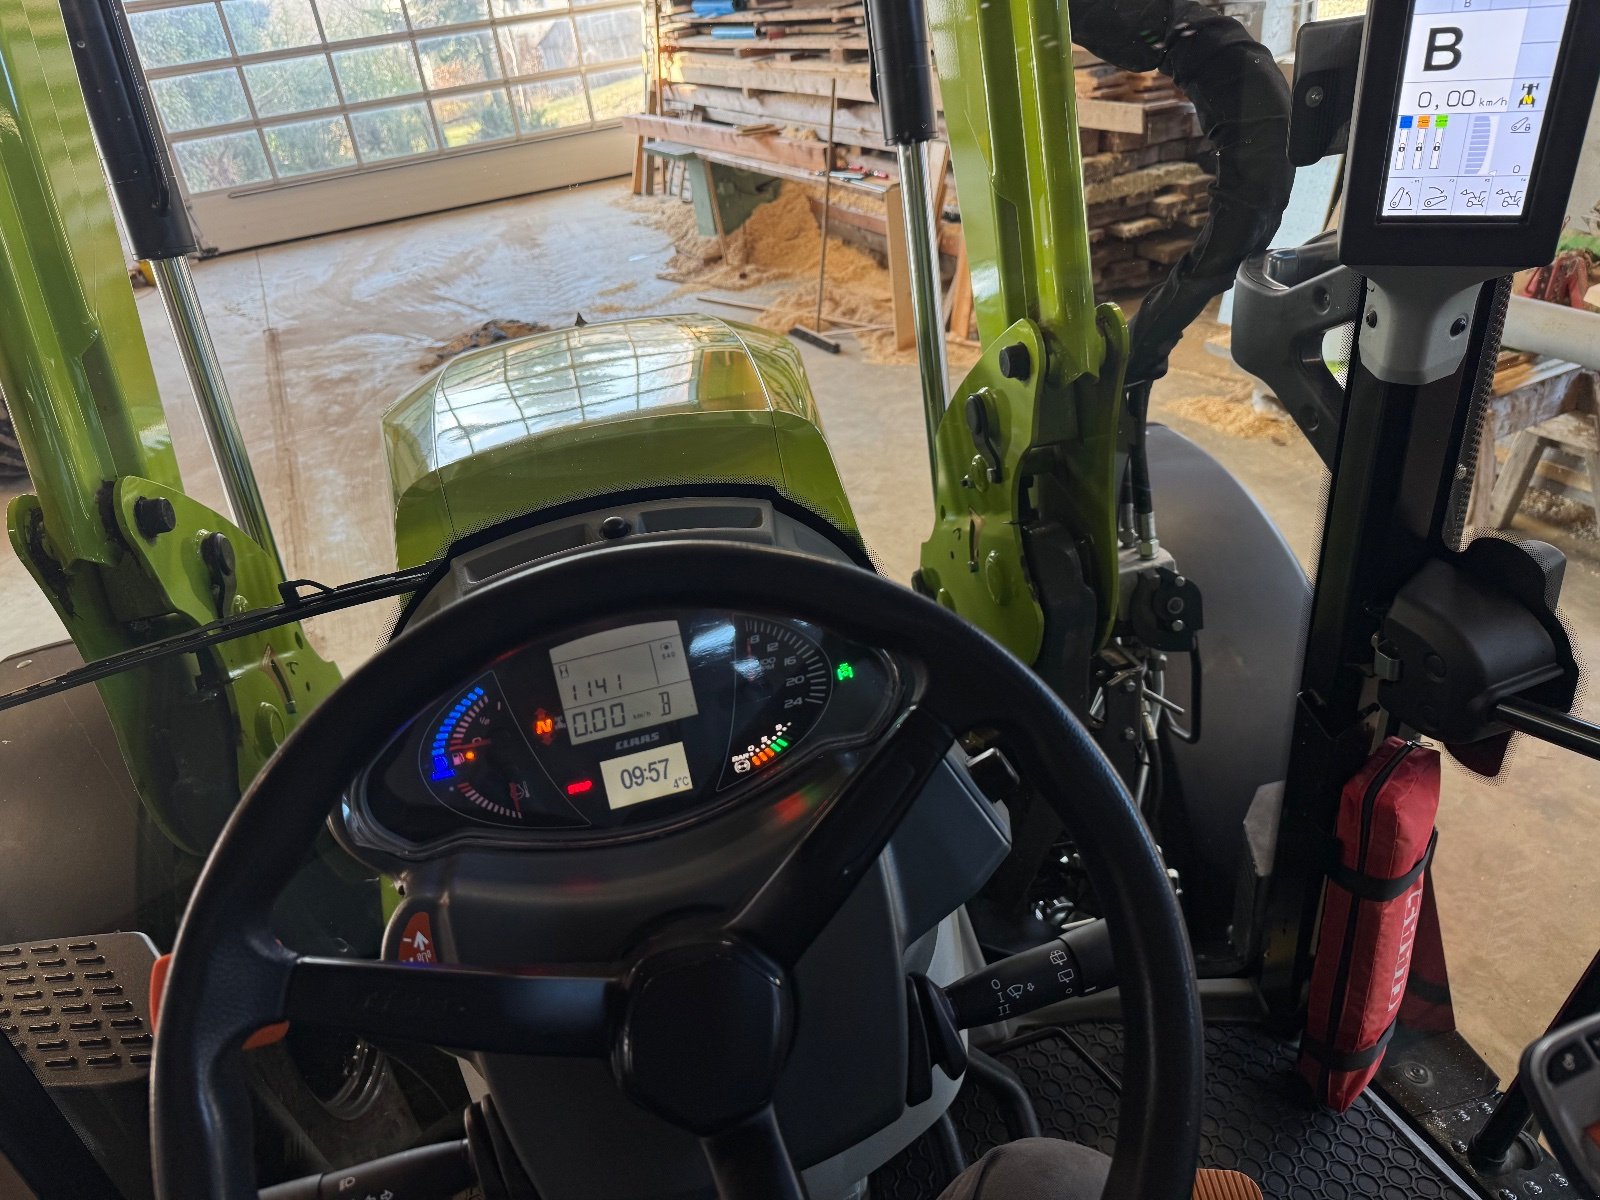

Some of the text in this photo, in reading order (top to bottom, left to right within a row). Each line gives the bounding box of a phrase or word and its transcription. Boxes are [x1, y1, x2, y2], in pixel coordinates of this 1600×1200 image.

[1423, 26, 1464, 72] B
[1418, 90, 1508, 110] 0,00 km/h
[784, 656, 796, 666] 16
[786, 675, 805, 687] 20
[784, 696, 803, 709] 24
[535, 718, 553, 735] N
[572, 702, 626, 738] 0.00
[615, 731, 660, 750] CLAAS
[620, 758, 670, 790] 09:57
[673, 776, 690, 789] 4°C
